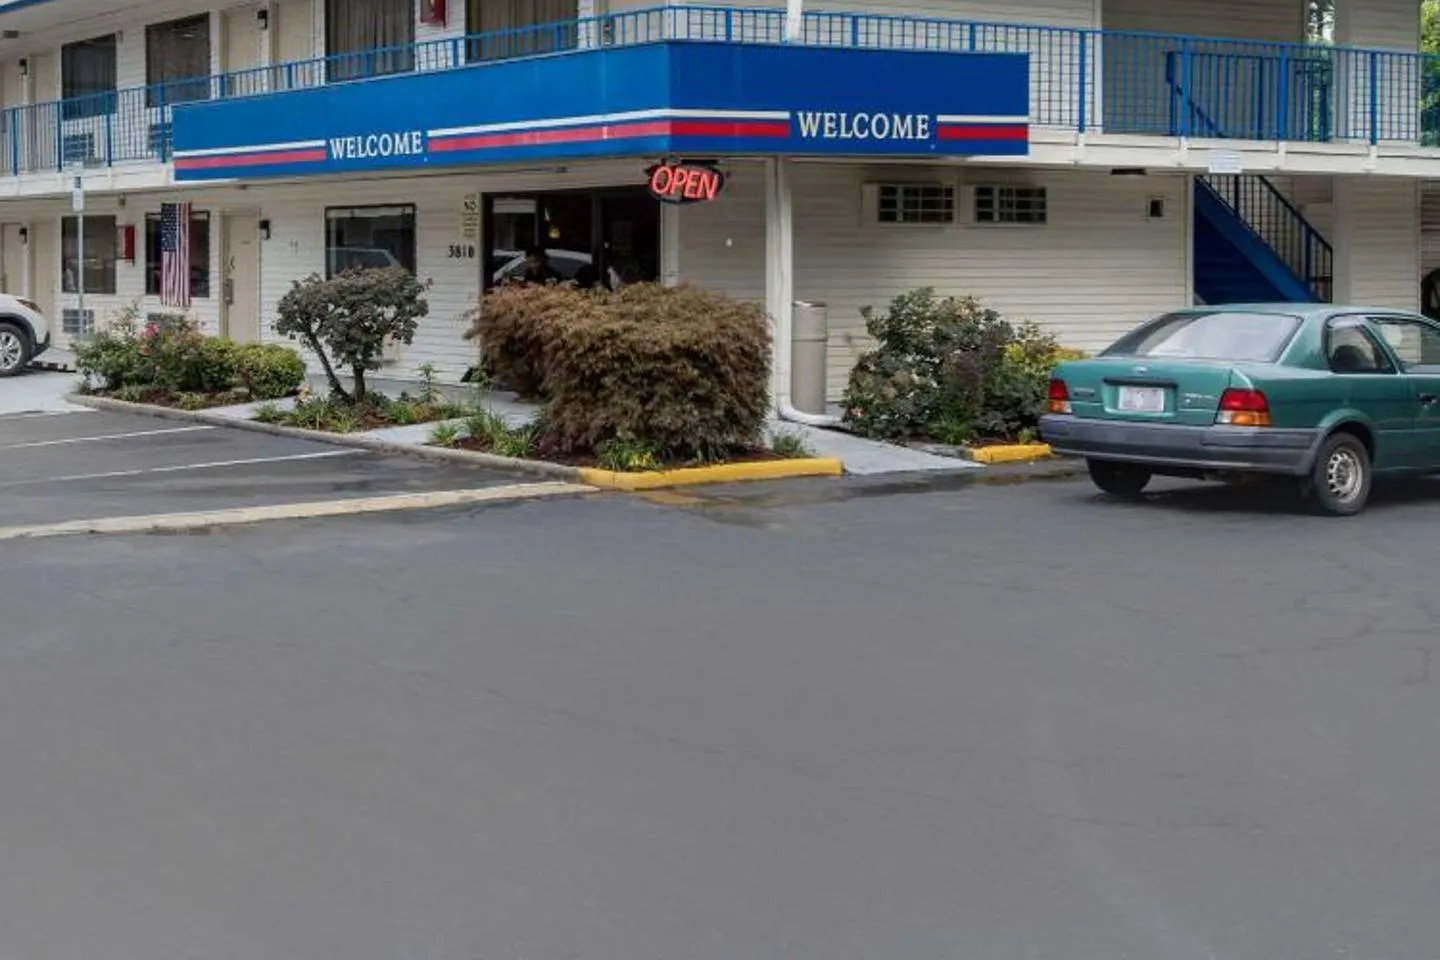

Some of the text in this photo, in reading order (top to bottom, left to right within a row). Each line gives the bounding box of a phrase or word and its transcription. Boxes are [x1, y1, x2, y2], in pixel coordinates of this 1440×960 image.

[797, 111, 930, 139] WELCOME
[329, 131, 423, 160] WELCOME
[652, 166, 719, 201] OPEN
